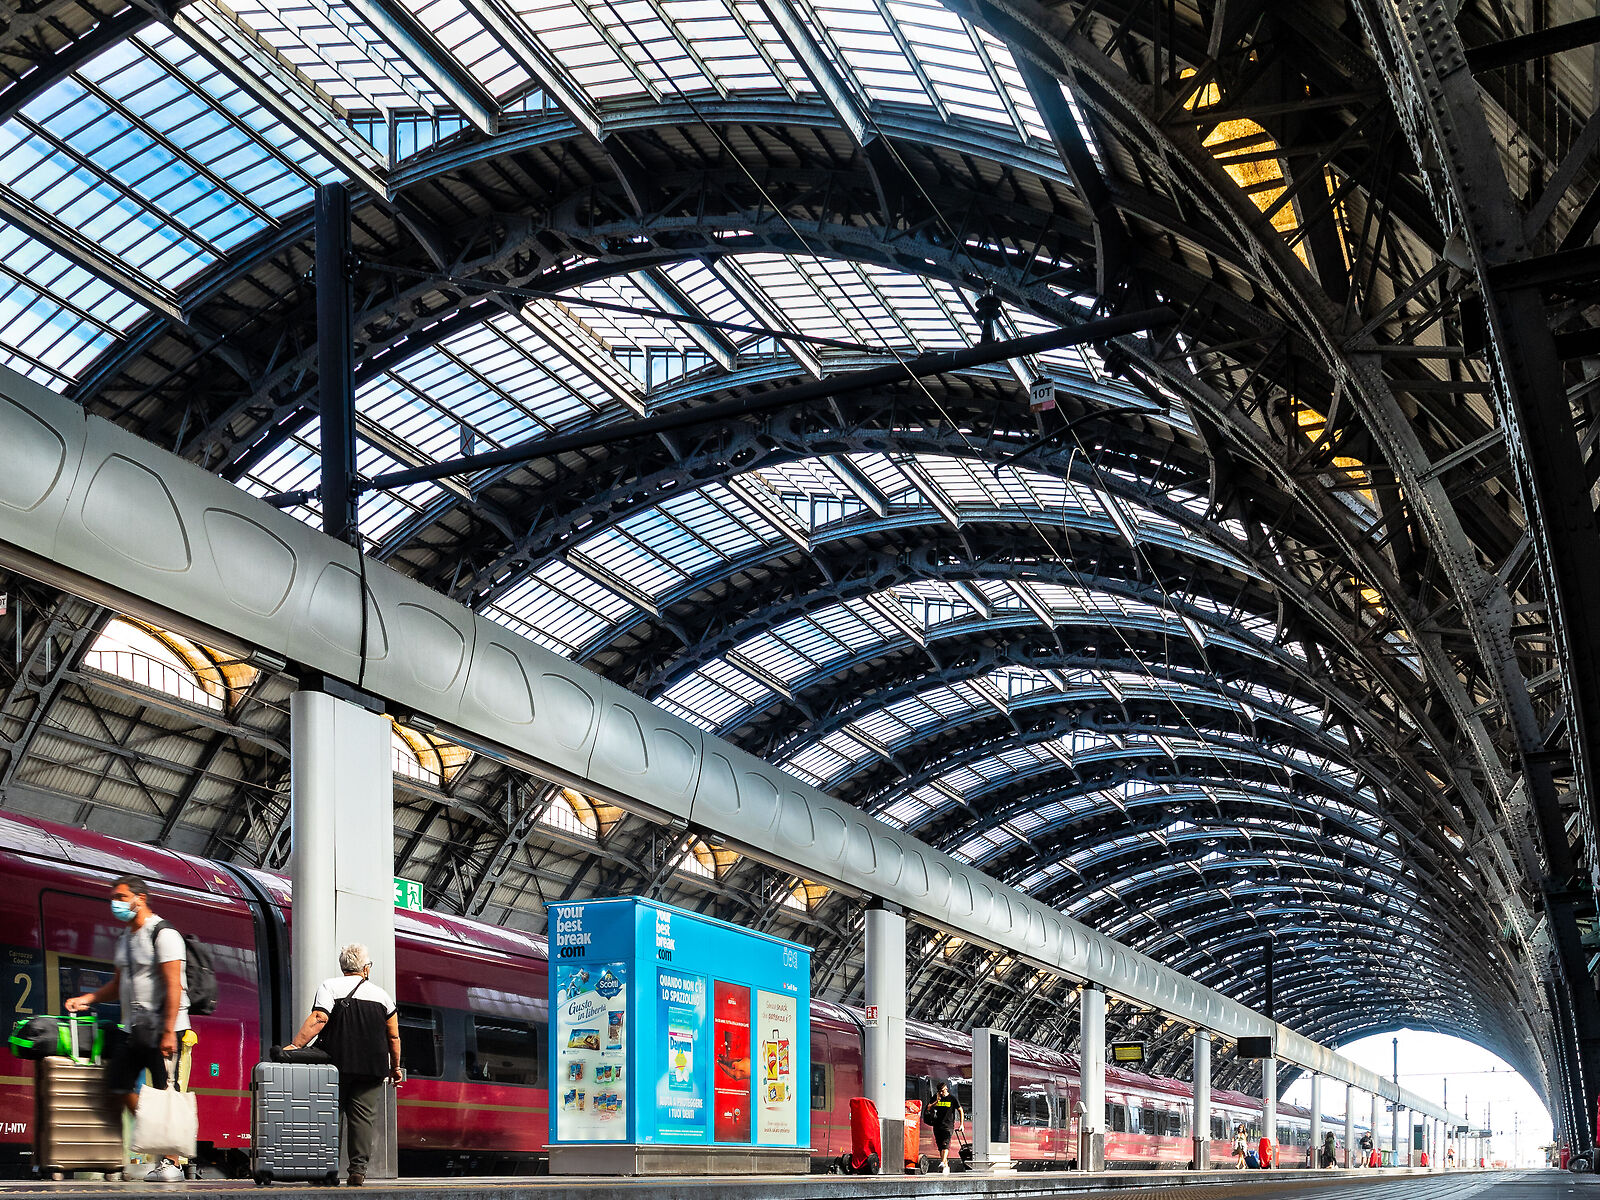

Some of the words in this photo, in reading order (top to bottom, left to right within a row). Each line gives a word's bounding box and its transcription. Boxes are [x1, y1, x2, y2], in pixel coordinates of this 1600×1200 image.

[1033, 386, 1052, 400] 10T
[556, 906, 584, 920] your
[656, 909, 672, 923] your
[556, 919, 582, 933] best
[656, 920, 670, 936] best
[556, 933, 592, 946] break
[656, 934, 675, 951] break
[556, 946, 585, 958] .com
[656, 948, 672, 962] .com
[660, 974, 682, 990] QUANDO
[683, 979, 694, 992] NON
[14, 973, 33, 1014] 2
[662, 988, 669, 1001] LO
[568, 1000, 592, 1015] Gusto
[578, 1012, 585, 1020] in
[4, 1123, 26, 1134] I-NTV
